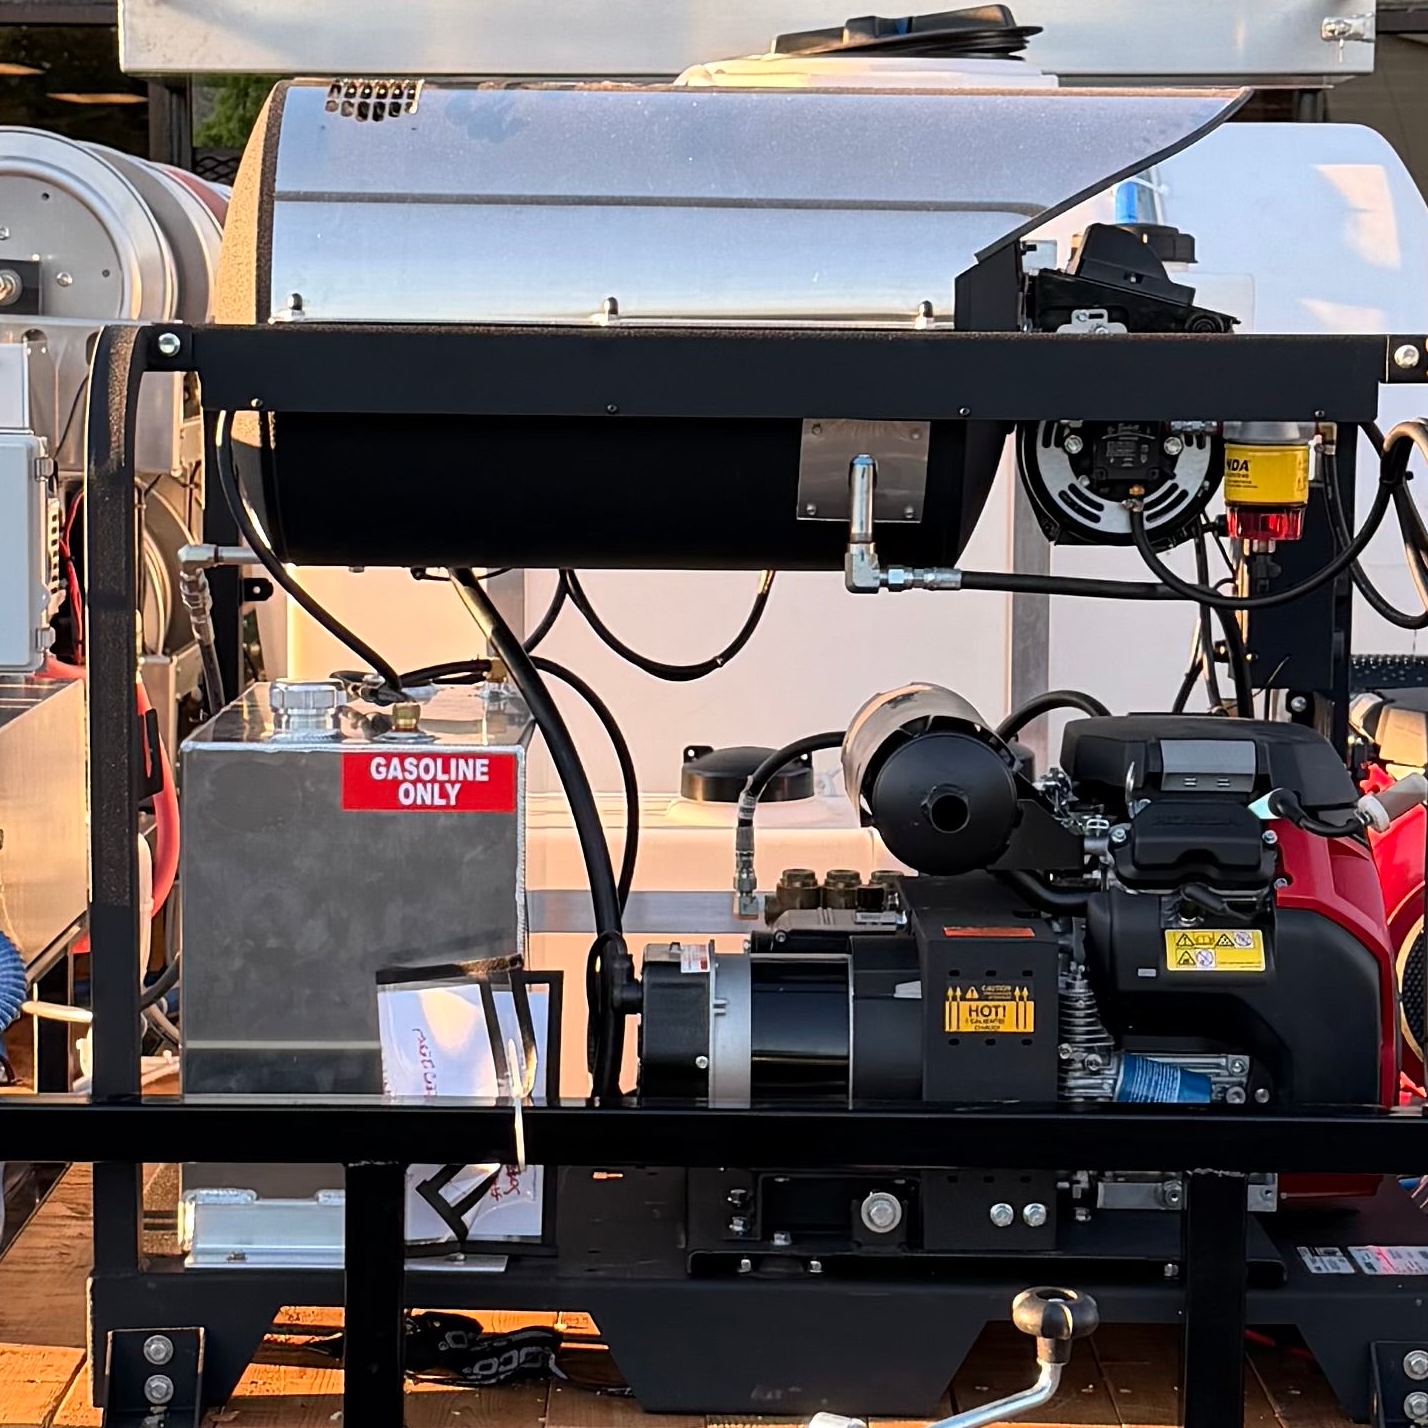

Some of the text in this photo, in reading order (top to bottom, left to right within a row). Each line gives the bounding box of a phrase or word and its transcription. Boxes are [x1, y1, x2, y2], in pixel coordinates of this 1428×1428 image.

[370, 756, 490, 782] GASOLINE
[398, 782, 461, 806] ONLY
[968, 1004, 1007, 1018] HOT!
